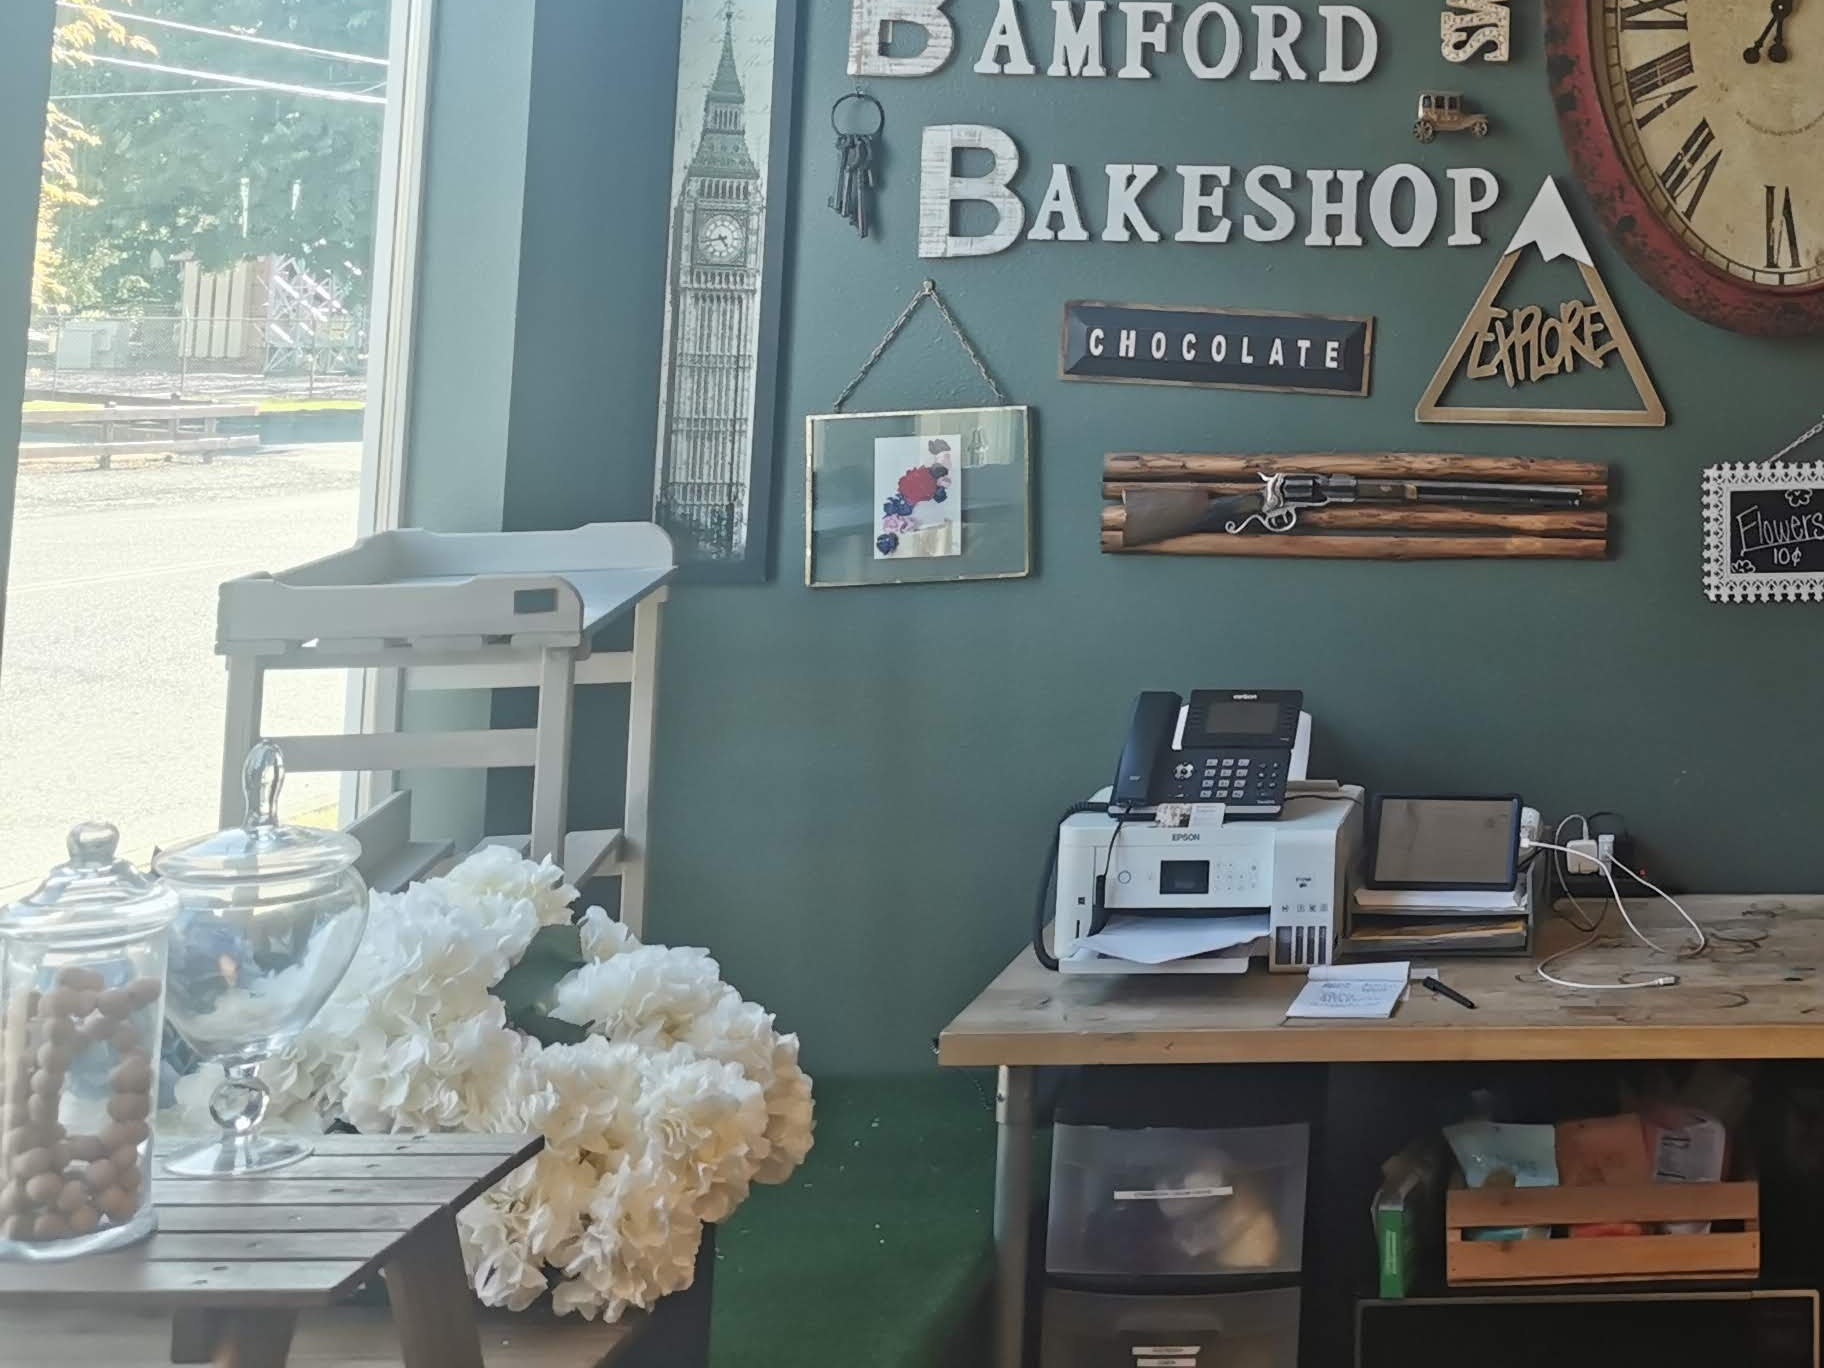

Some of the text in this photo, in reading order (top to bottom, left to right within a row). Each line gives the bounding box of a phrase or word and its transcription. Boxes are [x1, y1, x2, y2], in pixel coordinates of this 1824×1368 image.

[918, 123, 1500, 259] BAKESHOP
[1088, 328, 1340, 369] CHOCOLATE
[1467, 299, 1617, 388] EXPLORE
[1773, 546, 1803, 567] 10¢
[1171, 833, 1200, 841] EPSON
